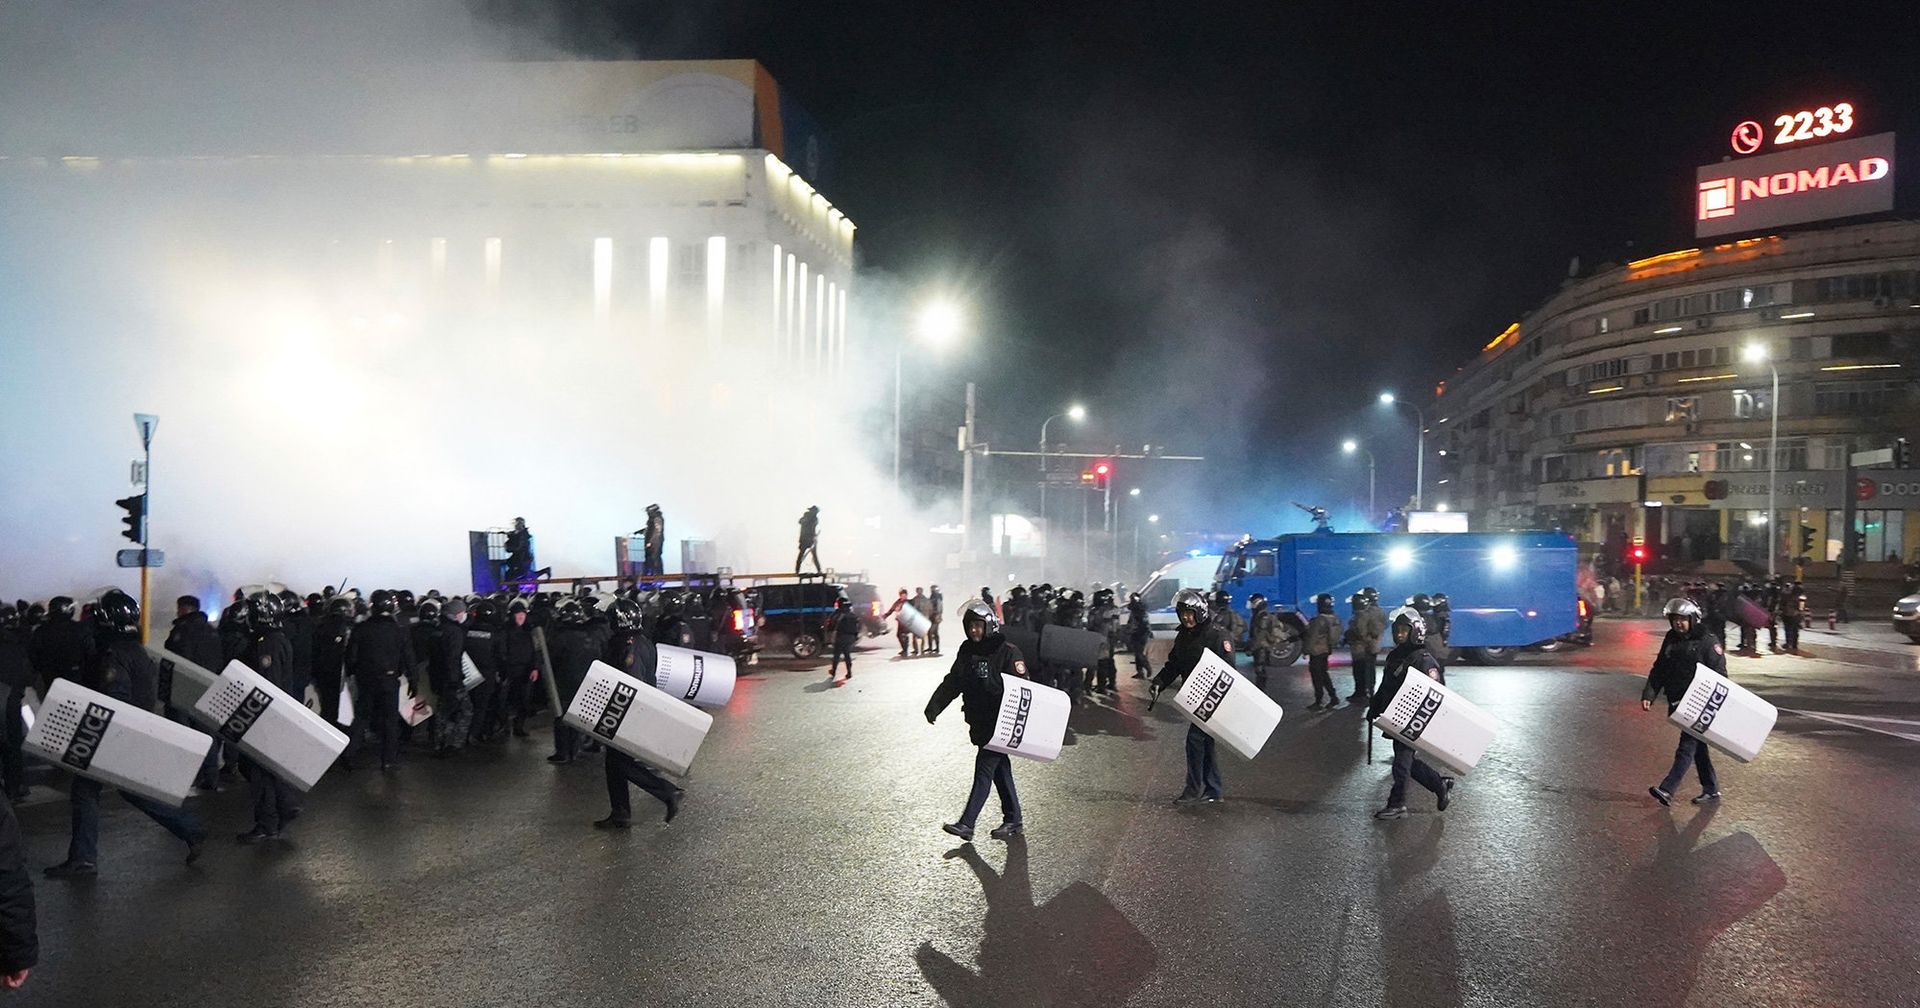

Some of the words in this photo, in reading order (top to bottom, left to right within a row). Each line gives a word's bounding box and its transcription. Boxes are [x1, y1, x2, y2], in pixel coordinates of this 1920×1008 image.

[1774, 103, 1854, 145] 2233
[1741, 157, 1889, 200] NOMAD
[596, 684, 634, 737] POLICE
[1009, 689, 1031, 746] POLICE
[1196, 672, 1232, 720] POLICE
[1404, 690, 1442, 739] POLICE
[1693, 684, 1728, 732] POLICE
[65, 704, 111, 767] POLICE
